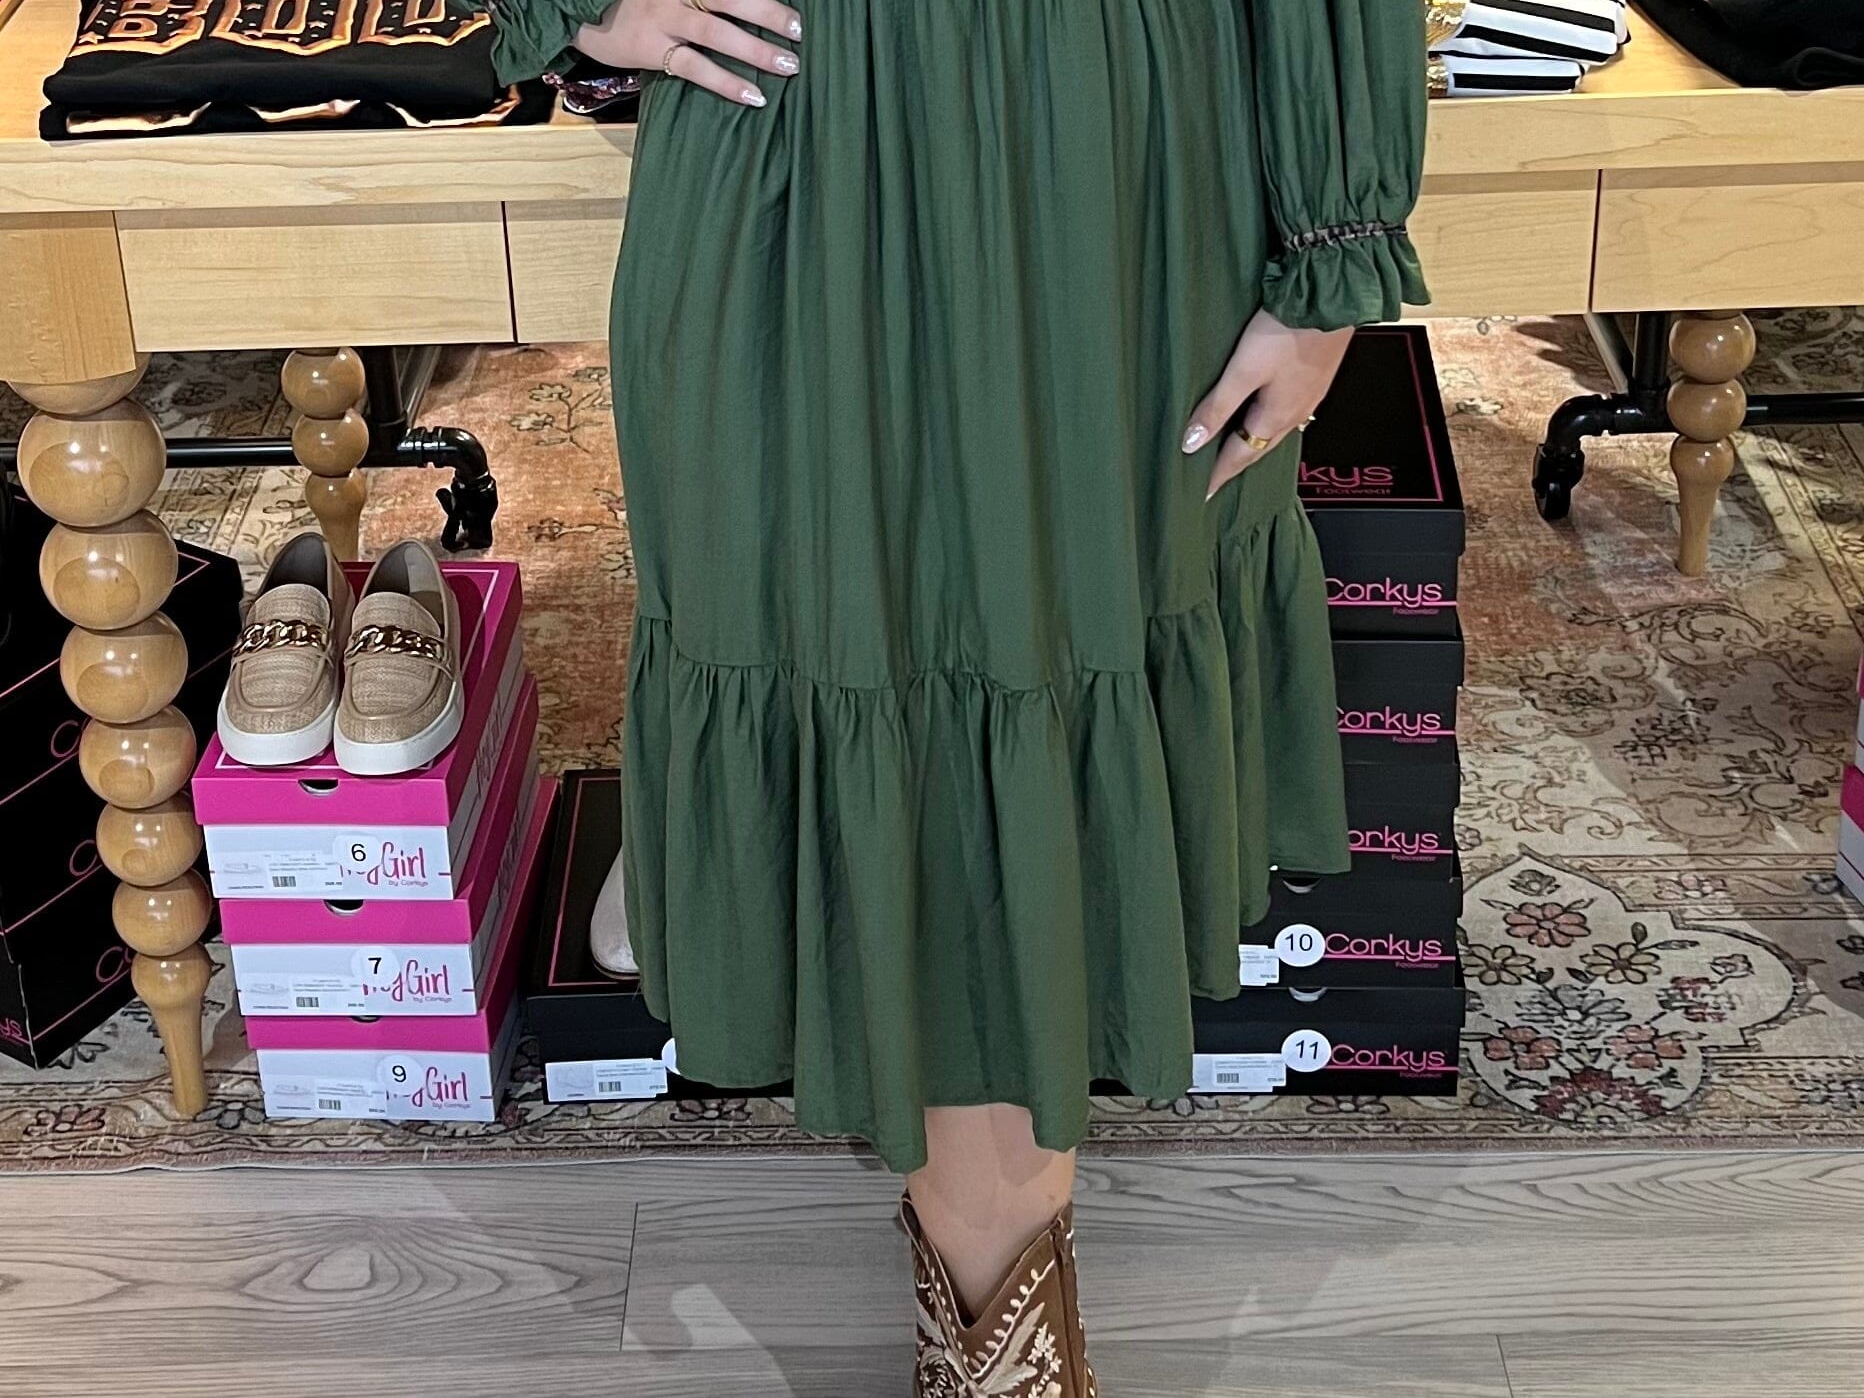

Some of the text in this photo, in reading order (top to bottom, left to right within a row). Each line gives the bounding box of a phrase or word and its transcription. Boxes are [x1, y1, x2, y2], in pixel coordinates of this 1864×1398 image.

[1347, 825, 1439, 855] orkys
[351, 843, 367, 862] 6
[1284, 933, 1313, 952] 10
[1325, 933, 1442, 962] Corkys
[367, 957, 382, 975] 7
[1295, 1040, 1319, 1060] 11
[1331, 1044, 1445, 1073] Corkys
[391, 1065, 407, 1083] 9
